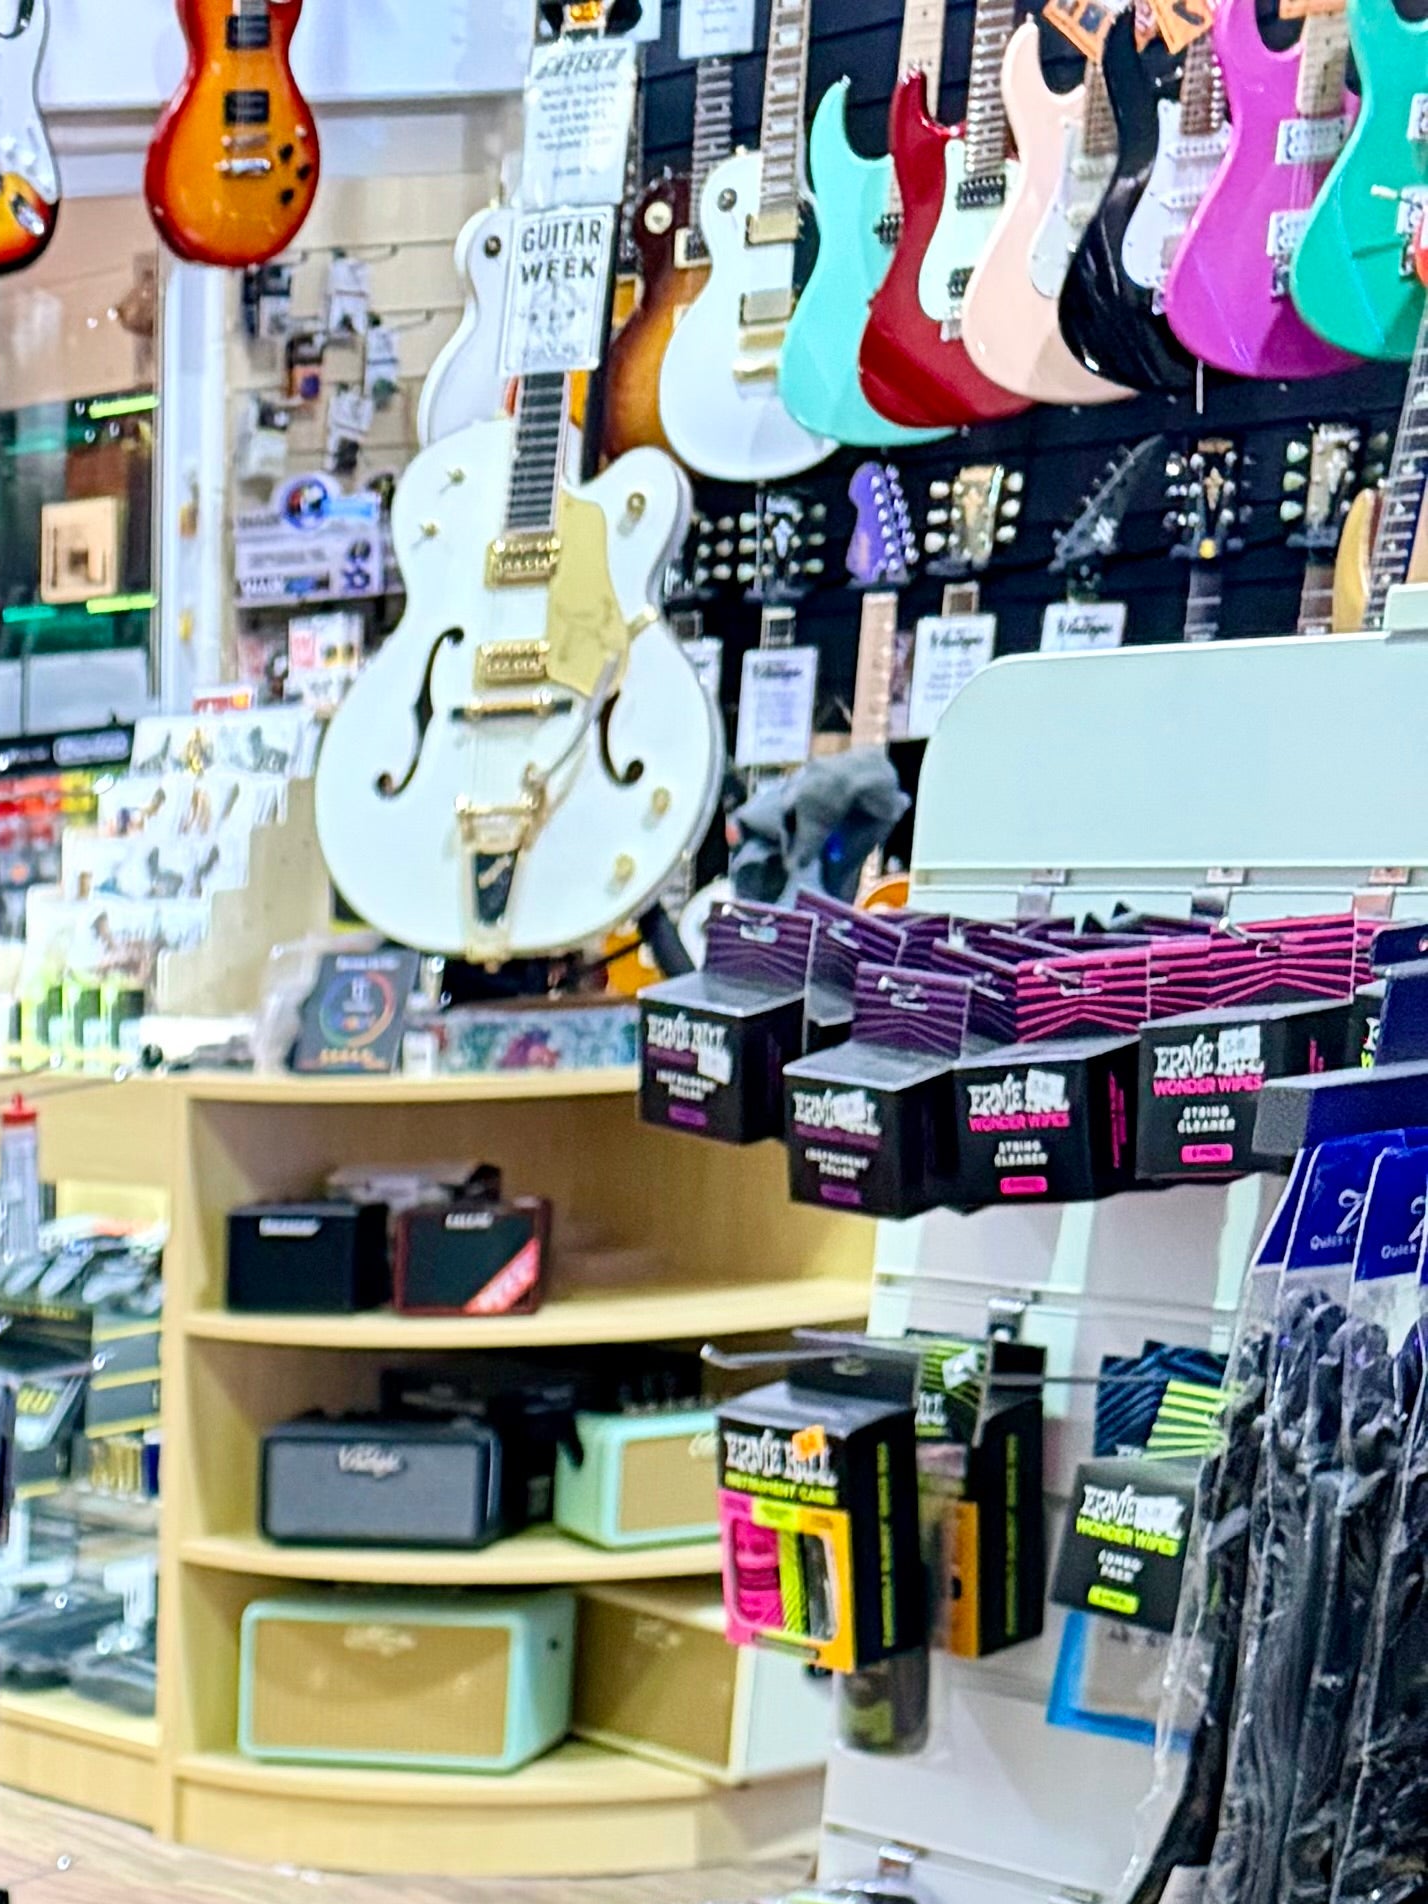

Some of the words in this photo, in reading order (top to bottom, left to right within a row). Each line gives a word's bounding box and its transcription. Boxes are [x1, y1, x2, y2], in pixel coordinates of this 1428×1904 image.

[521, 219, 603, 253] GUITAR
[521, 256, 598, 285] WEEK
[1153, 1034, 1214, 1077] ERNIE
[967, 1073, 1023, 1116] ERNIE
[1153, 1077, 1215, 1097] WONDER
[1218, 1074, 1264, 1093] WIPES
[968, 1112, 1026, 1133] WONDER
[724, 1428, 782, 1477] ERNIE
